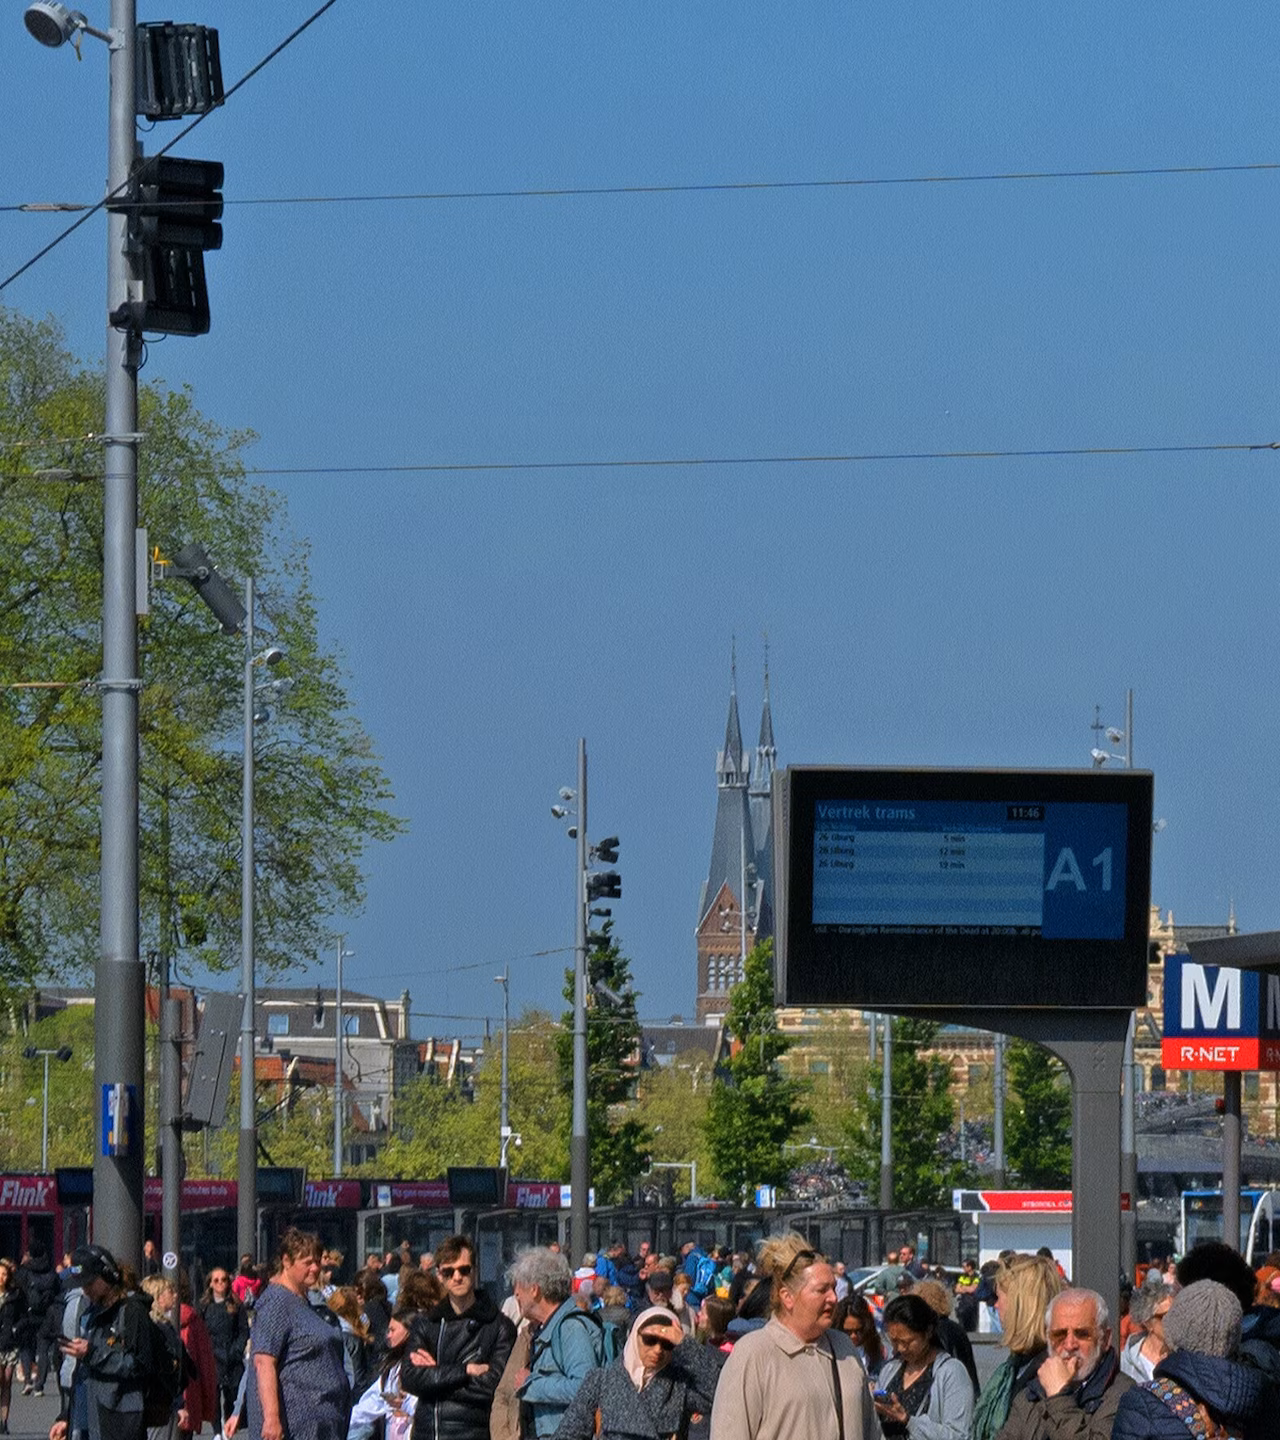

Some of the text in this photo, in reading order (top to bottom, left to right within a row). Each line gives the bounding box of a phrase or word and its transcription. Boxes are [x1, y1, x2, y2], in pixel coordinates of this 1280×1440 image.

[817, 804, 916, 820] Vertrek trams
[1012, 808, 1040, 818] 11:46
[1045, 847, 1113, 891] A1
[1181, 963, 1241, 1029] M
